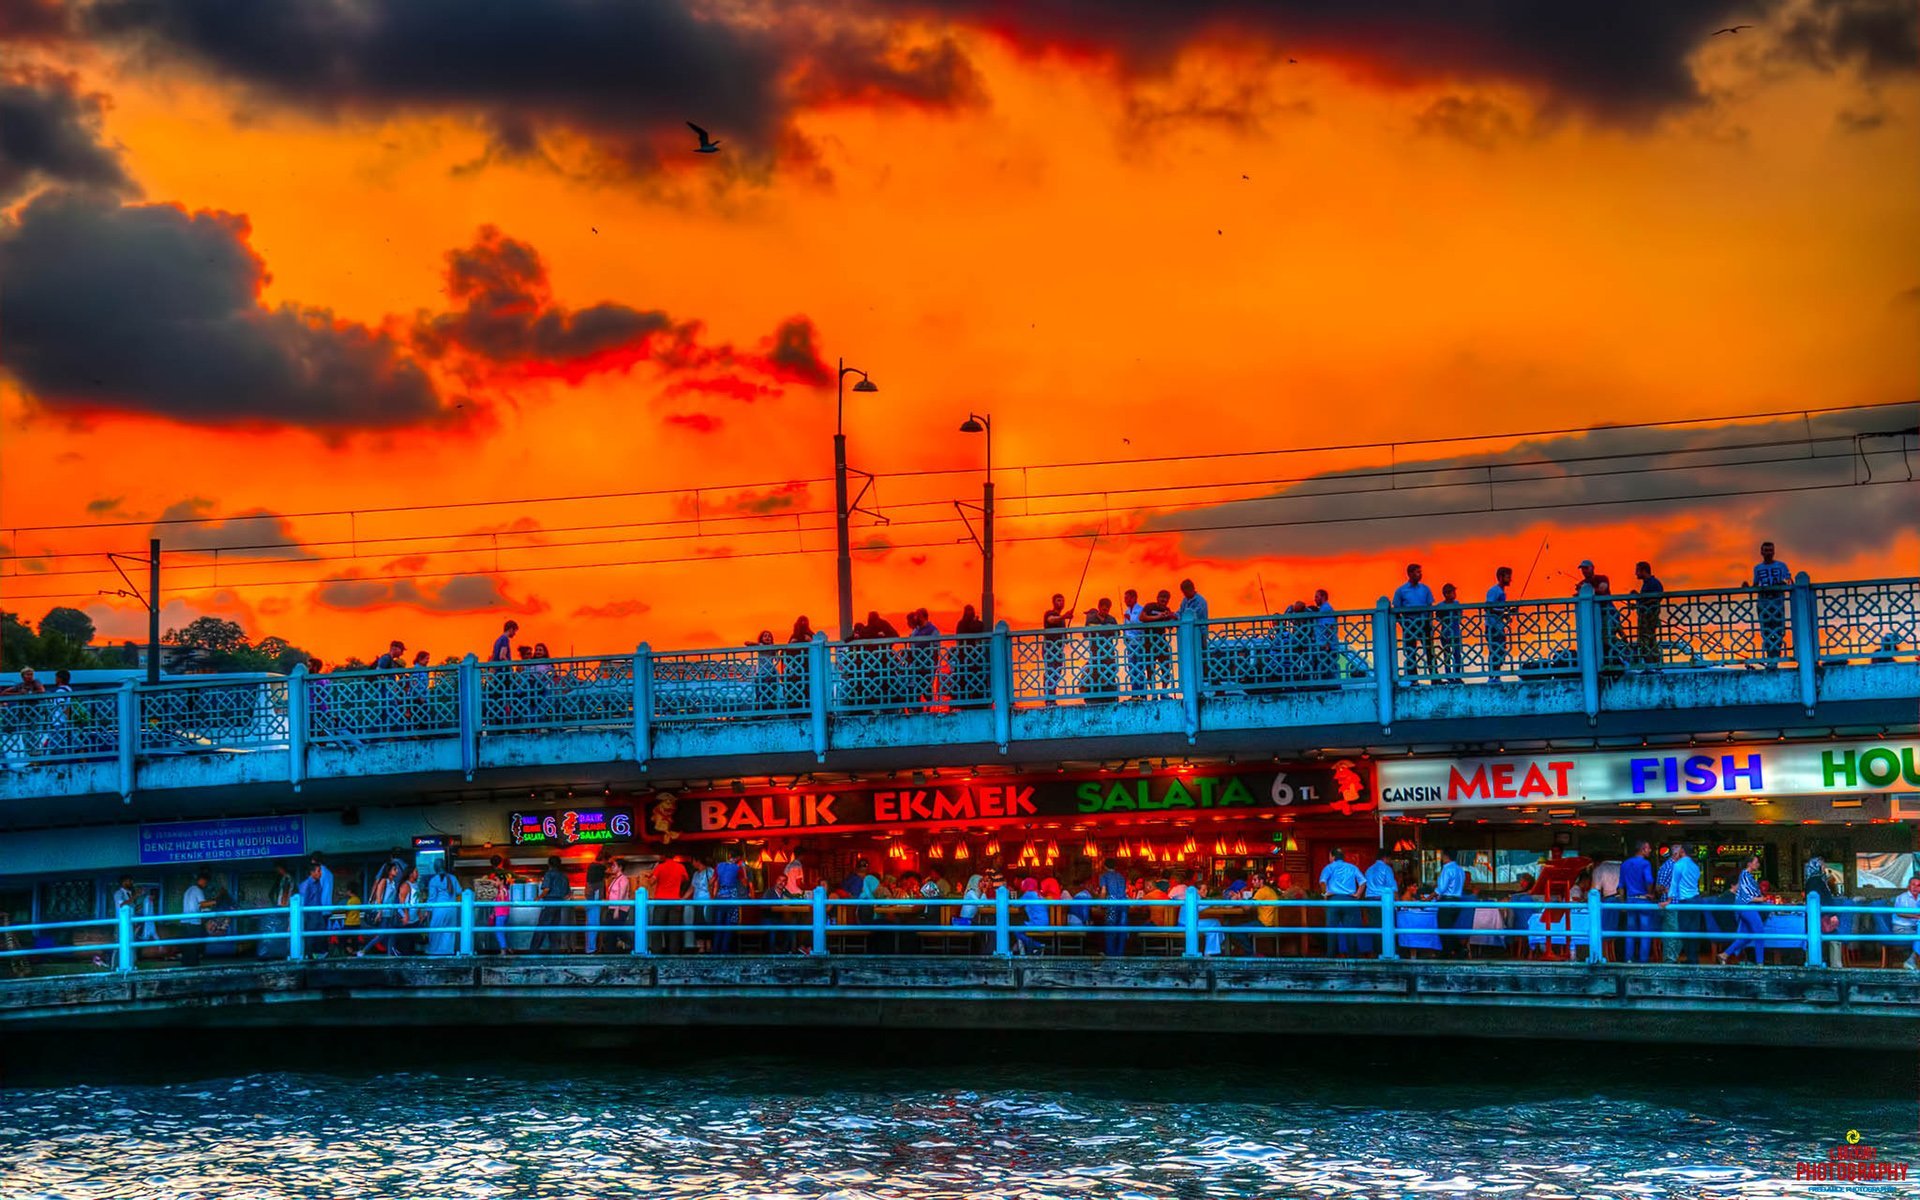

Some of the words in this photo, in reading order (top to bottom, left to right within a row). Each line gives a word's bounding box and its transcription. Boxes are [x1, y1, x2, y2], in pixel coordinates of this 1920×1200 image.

[1382, 786, 1441, 803] CANSIN
[1447, 761, 1574, 800] MEAT
[1630, 754, 1763, 793] FISH
[701, 793, 838, 831] BALIK
[873, 785, 1038, 821] EKMEK
[1076, 776, 1255, 813] SALATA
[1271, 772, 1294, 806] 6
[1300, 785, 1320, 800] TL
[543, 816, 557, 837] 6
[611, 814, 631, 835] 6
[144, 840, 174, 852] DENİZ
[175, 837, 235, 850] HİZMETLERİ
[523, 833, 545, 841] SALATA
[580, 831, 612, 840] SALATA
